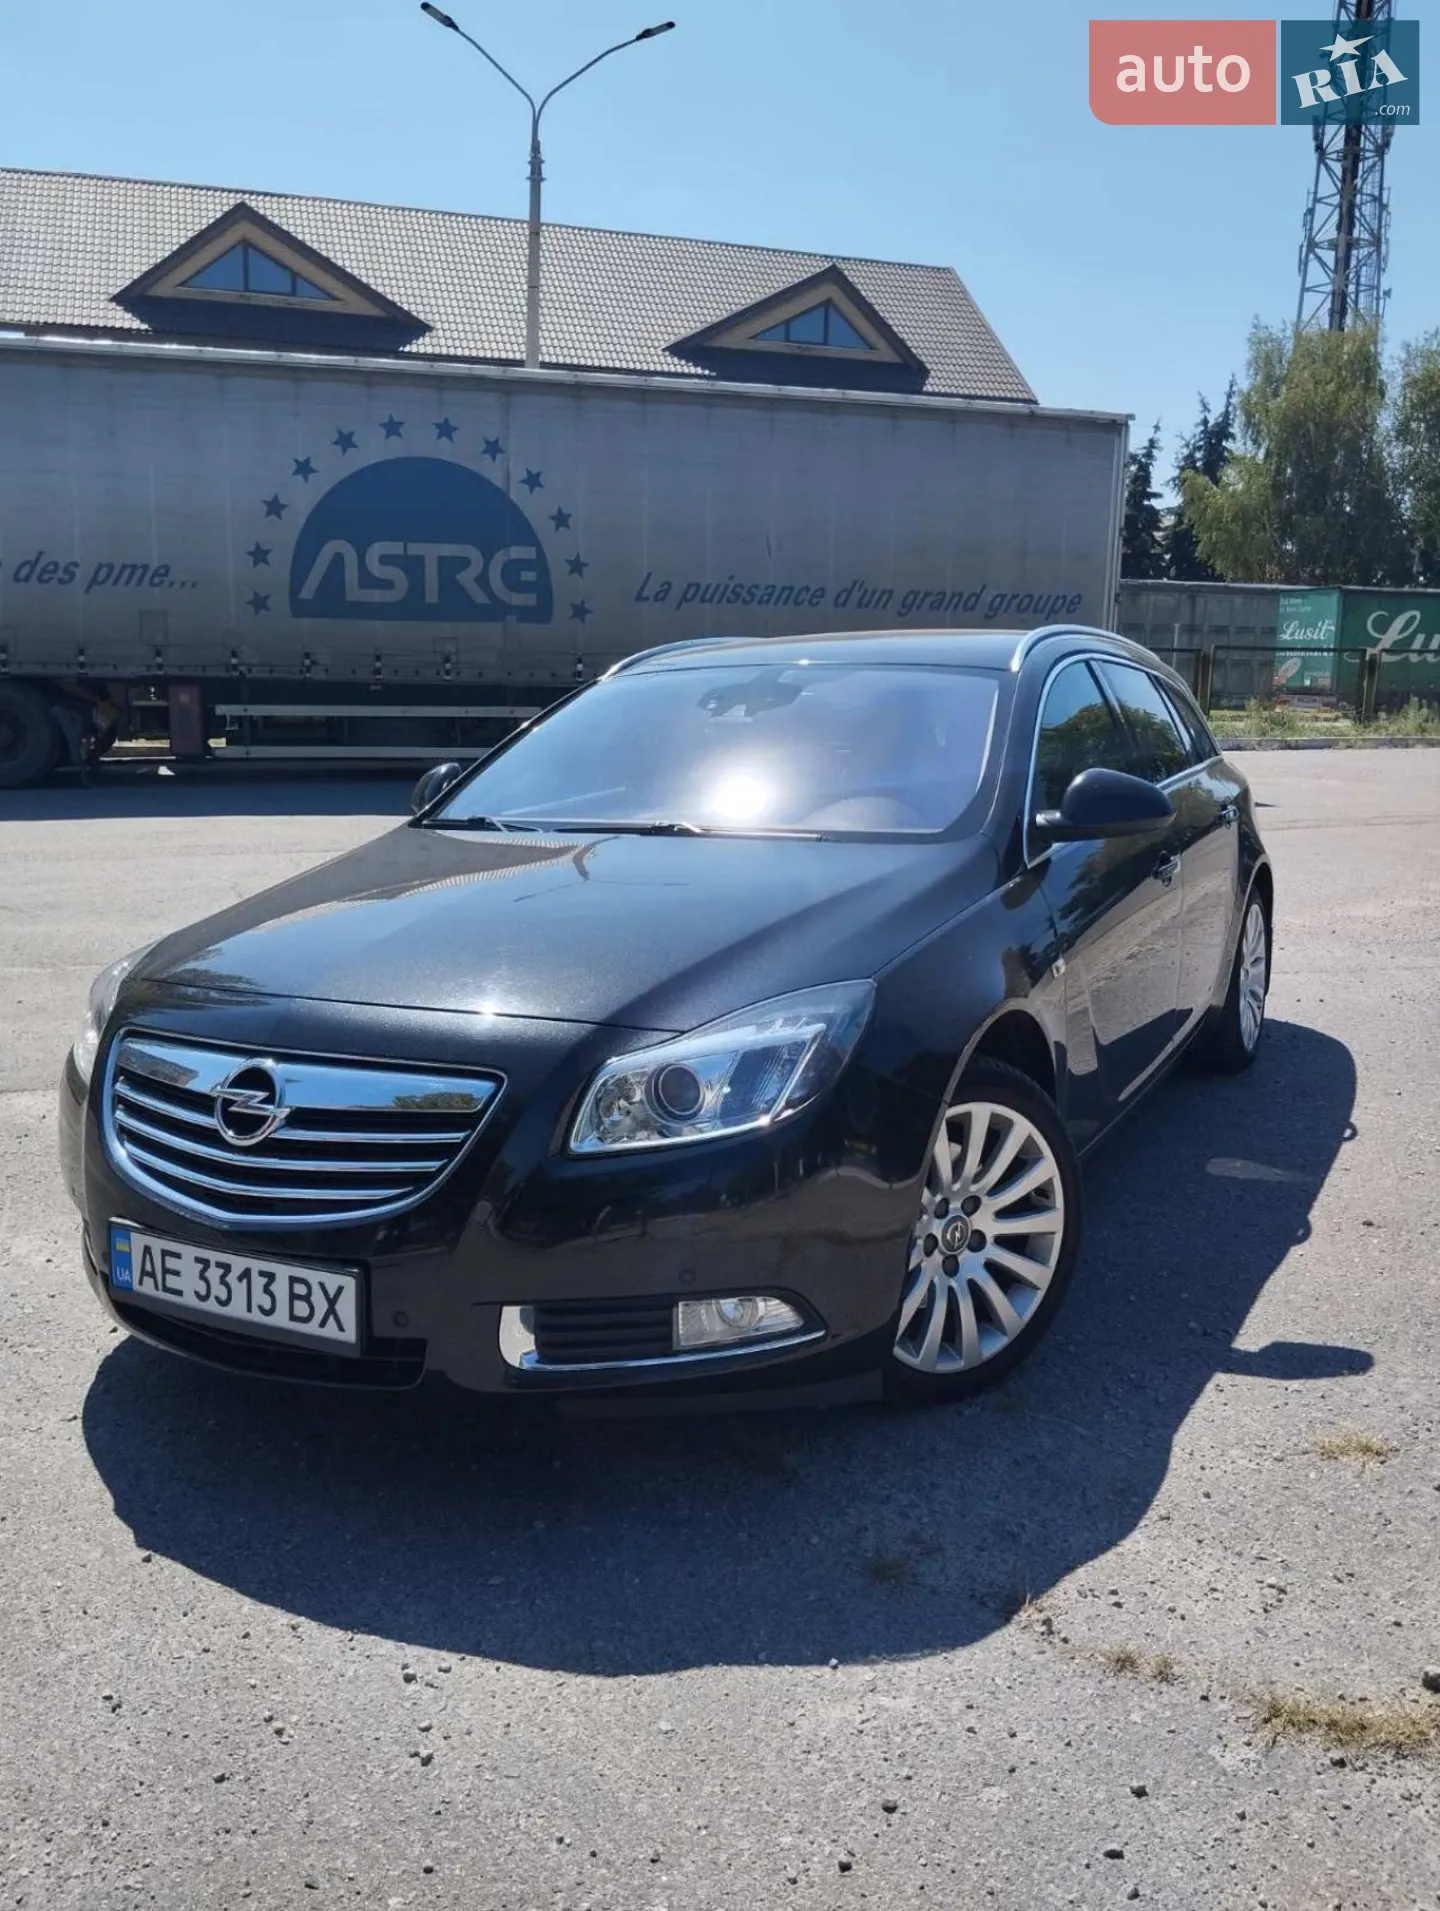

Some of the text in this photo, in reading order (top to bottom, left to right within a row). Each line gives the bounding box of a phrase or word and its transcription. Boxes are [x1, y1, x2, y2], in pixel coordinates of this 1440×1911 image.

[13, 550, 199, 594] des pme...
[298, 539, 538, 607] ASTRE
[634, 572, 1083, 620] La puissance d'un grand groupe
[116, 1266, 132, 1283] UA
[138, 1245, 346, 1332] AE 3313 BX
